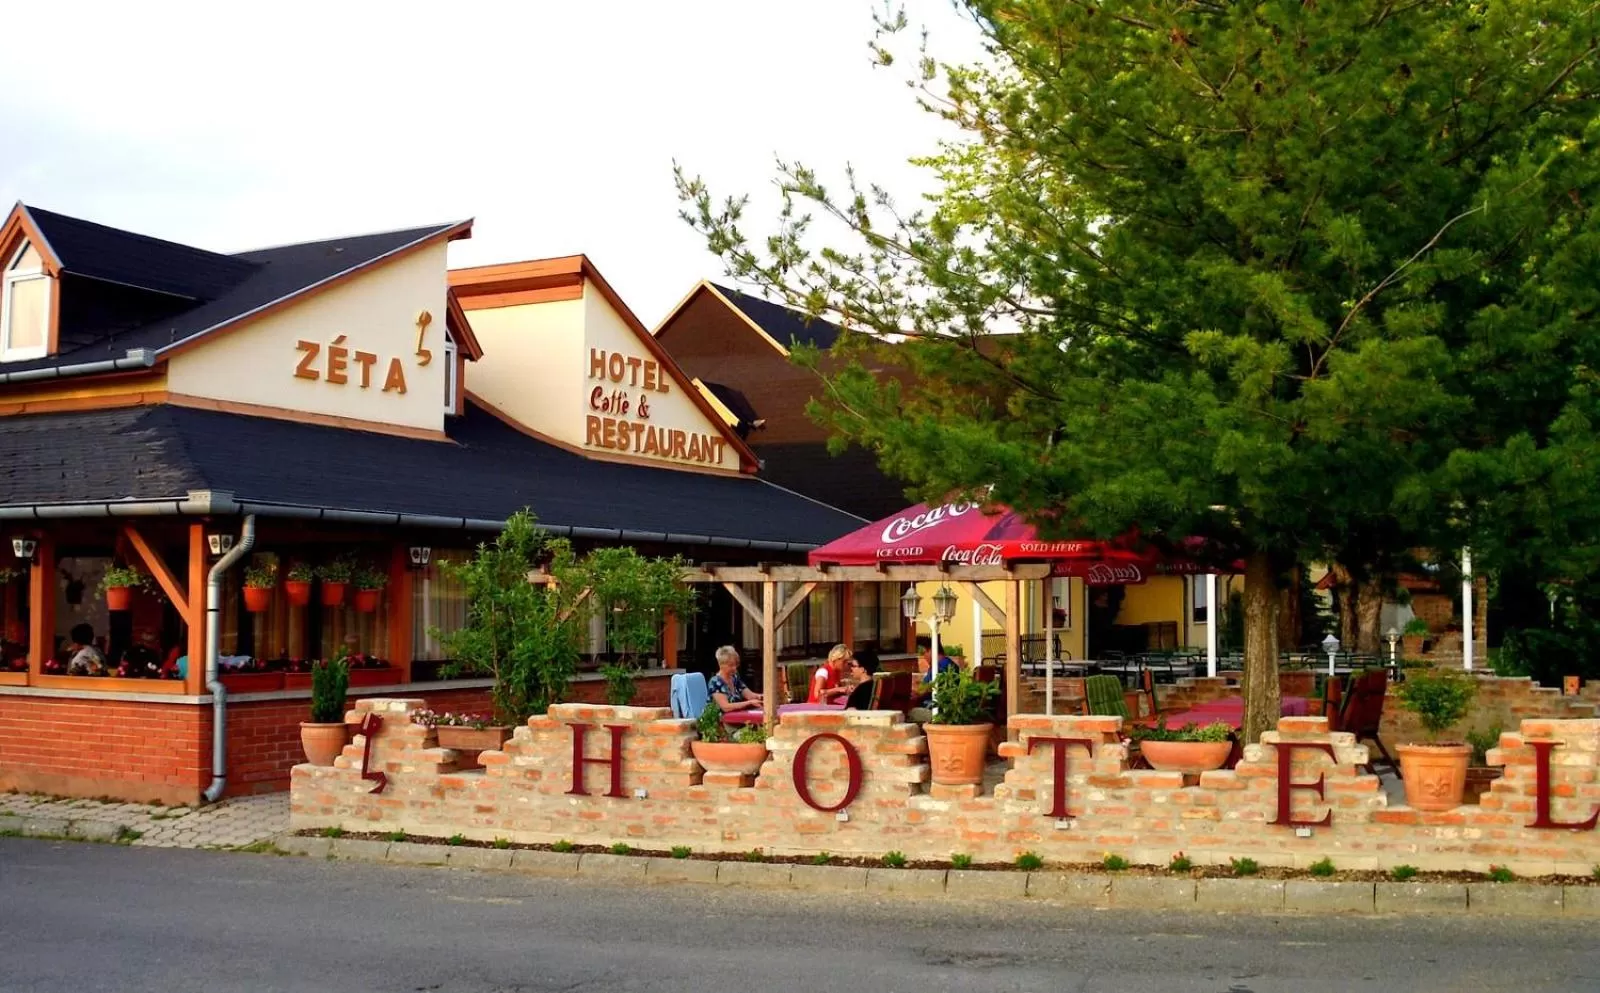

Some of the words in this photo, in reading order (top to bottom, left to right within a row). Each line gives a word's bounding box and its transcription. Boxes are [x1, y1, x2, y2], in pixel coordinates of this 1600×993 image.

[294, 335, 408, 394] ZÉTA
[589, 348, 670, 393] HOTEL
[638, 393, 651, 418] &
[585, 415, 726, 465] RESTAURANT
[881, 494, 986, 544] Coca-C
[877, 548, 893, 559] ICE
[896, 546, 924, 557] COLD
[941, 543, 1005, 566] Coca-Cola
[1020, 543, 1049, 553] SOLD
[568, 722, 1600, 830] HOTEL
